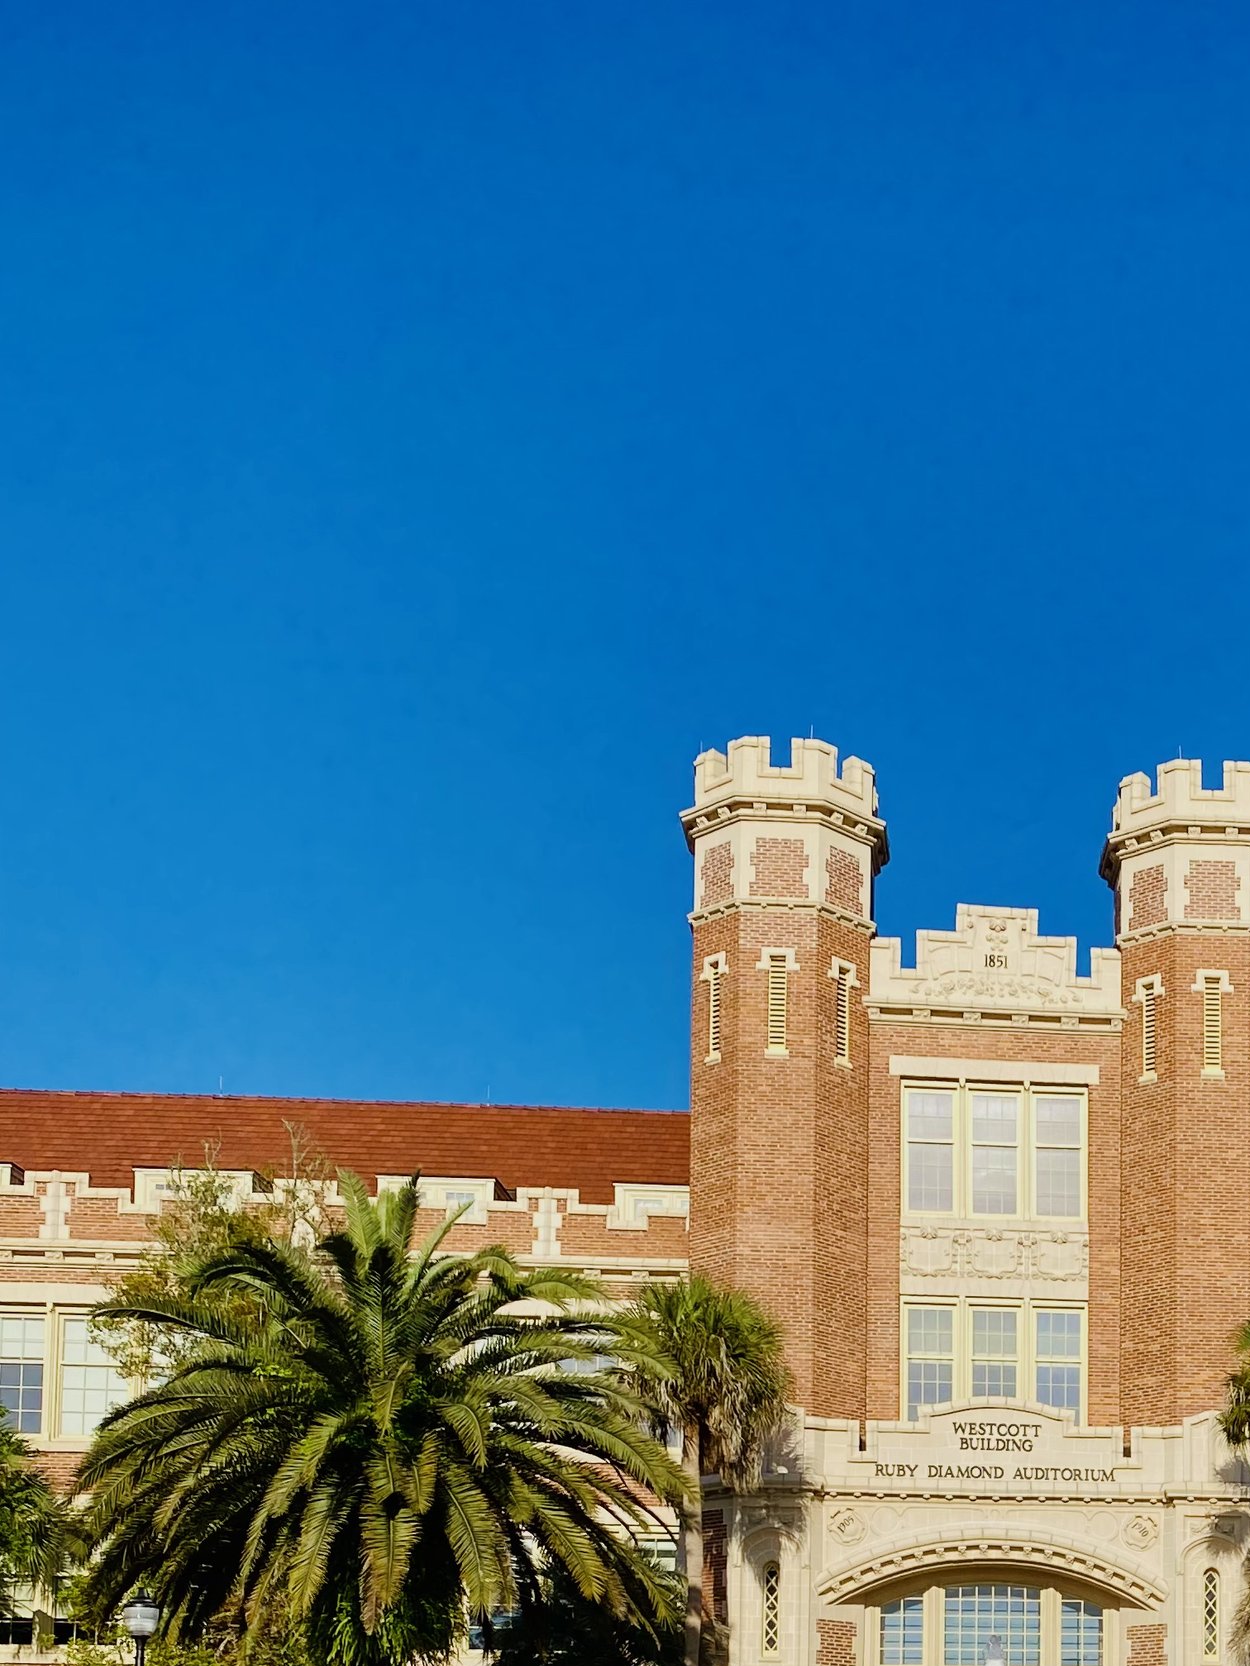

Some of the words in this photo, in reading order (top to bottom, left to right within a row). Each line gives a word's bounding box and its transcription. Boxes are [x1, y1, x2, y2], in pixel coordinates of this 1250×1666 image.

[984, 954, 1008, 969] 1851
[952, 1422, 1042, 1438] WESTCOTT
[959, 1438, 1034, 1452] BUILDING
[875, 1464, 919, 1478] RUBY
[927, 1465, 1005, 1480] DIAMOND
[1013, 1467, 1116, 1482] AUDITORIUM
